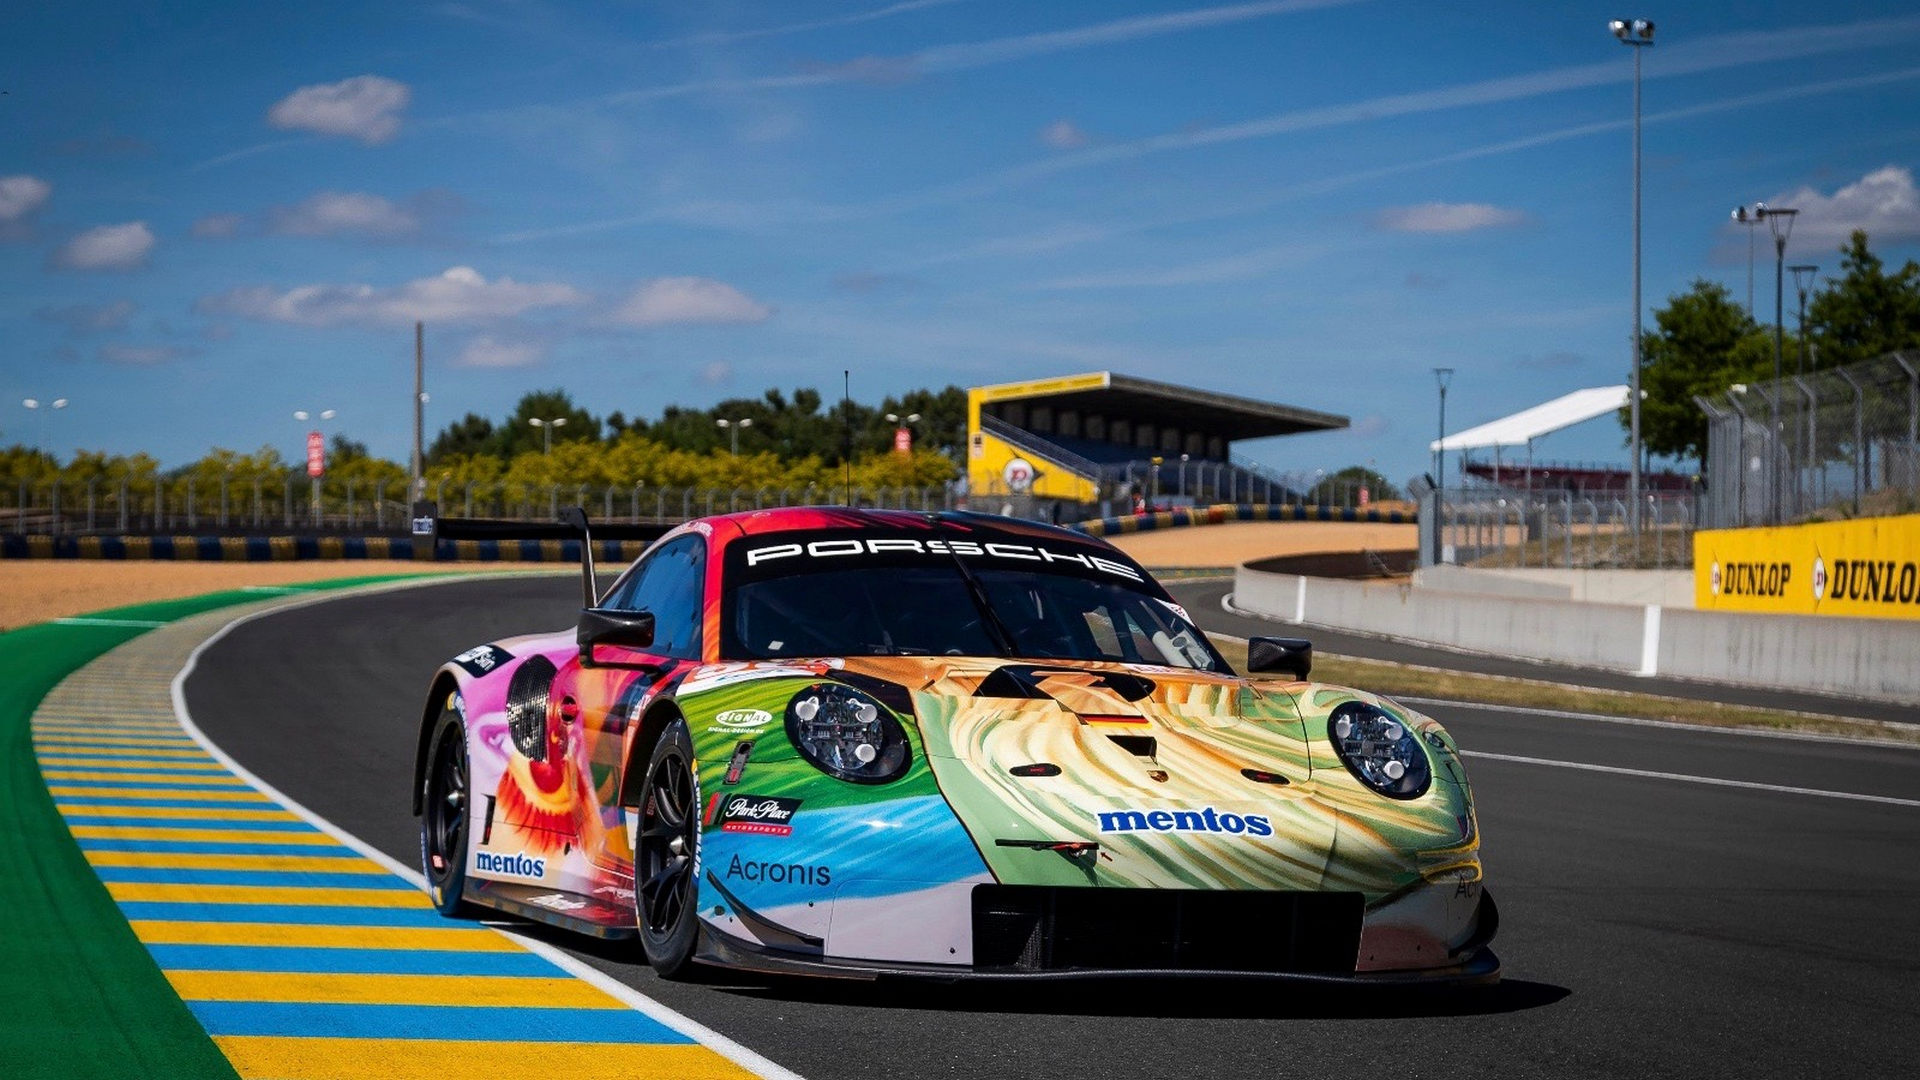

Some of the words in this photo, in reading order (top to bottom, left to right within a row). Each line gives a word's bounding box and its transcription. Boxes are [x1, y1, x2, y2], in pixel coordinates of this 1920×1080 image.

[746, 539, 1145, 583] PORSCHE
[1724, 563, 1791, 596] DUNLOP
[1830, 559, 1920, 605] DUNLO
[1098, 807, 1272, 836] mentos
[477, 852, 545, 877] mentos
[727, 854, 831, 886] Acronis
